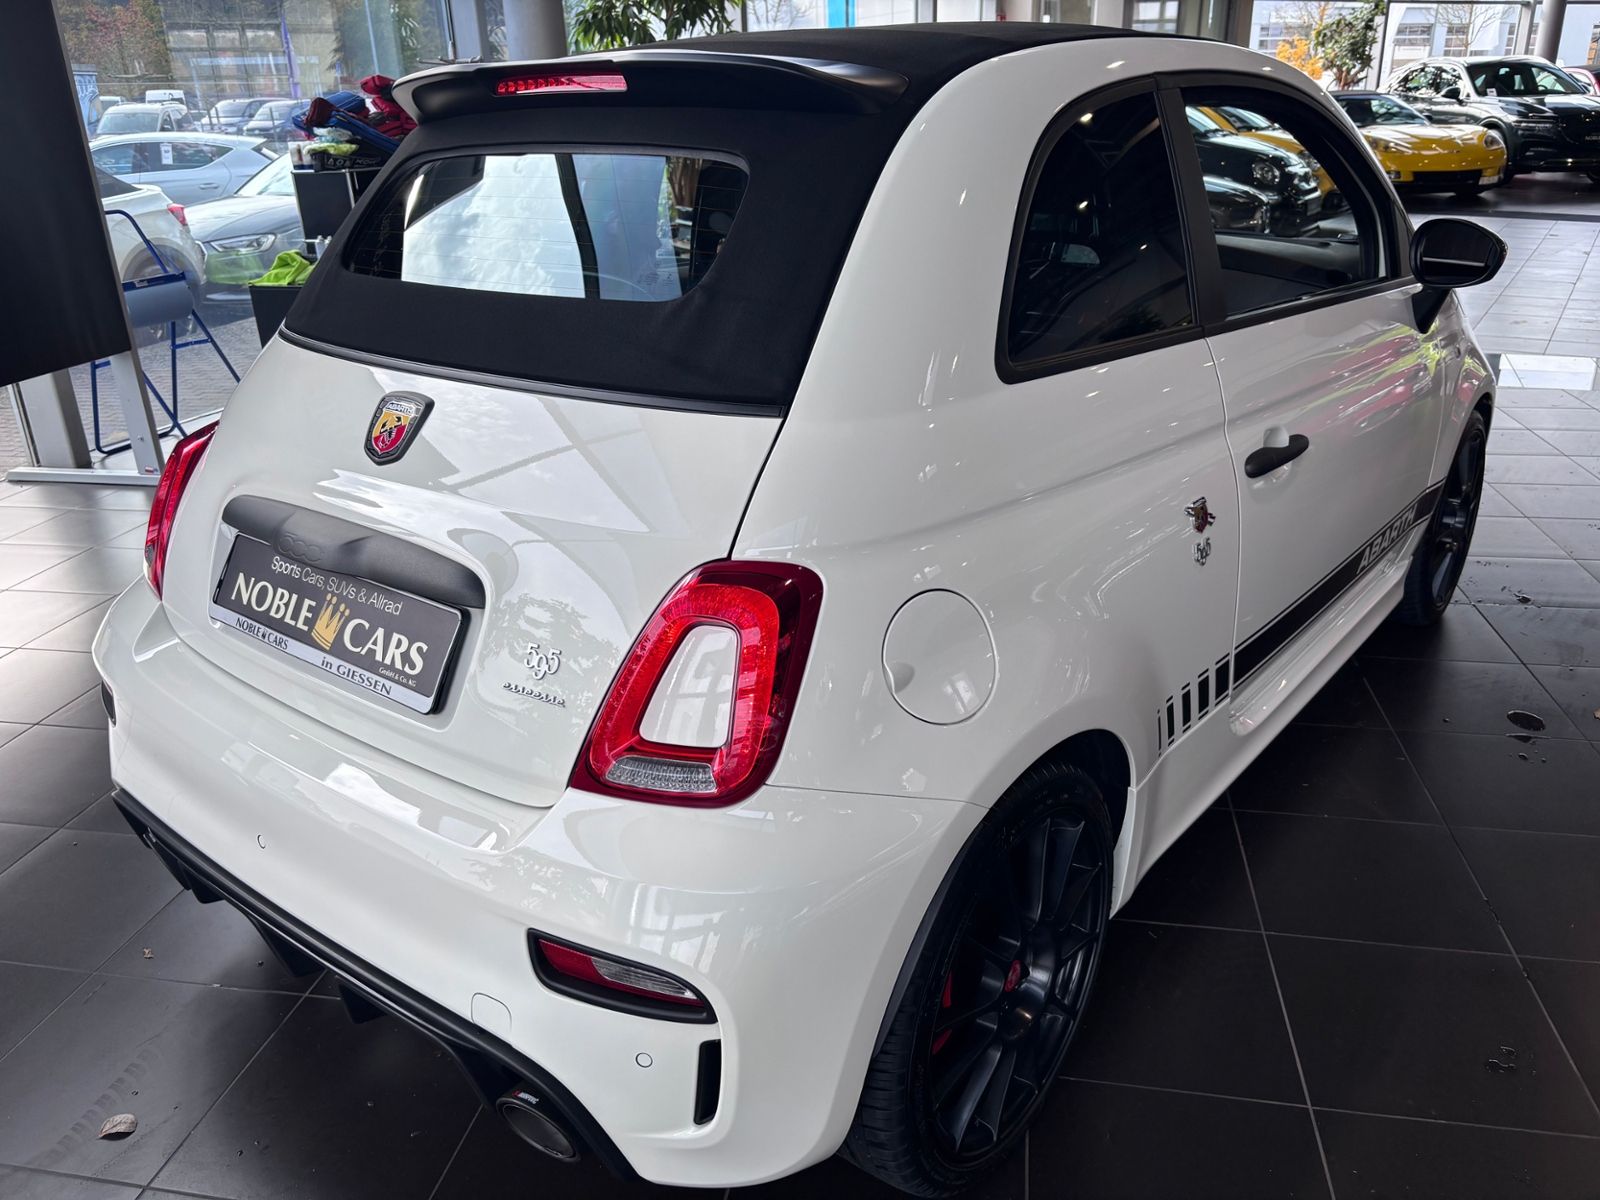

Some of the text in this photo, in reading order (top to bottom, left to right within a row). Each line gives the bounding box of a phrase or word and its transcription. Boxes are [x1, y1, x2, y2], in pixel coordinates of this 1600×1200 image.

[1356, 503, 1418, 575] ABARTH
[271, 556, 403, 615] Sports Cars, SUVs & Allrad
[231, 572, 428, 676] NOBLE CARS
[235, 617, 289, 650] NOBLE CARS
[321, 656, 392, 695] in GIESSEN
[379, 667, 395, 679] GmbH
[524, 642, 562, 680] 595
